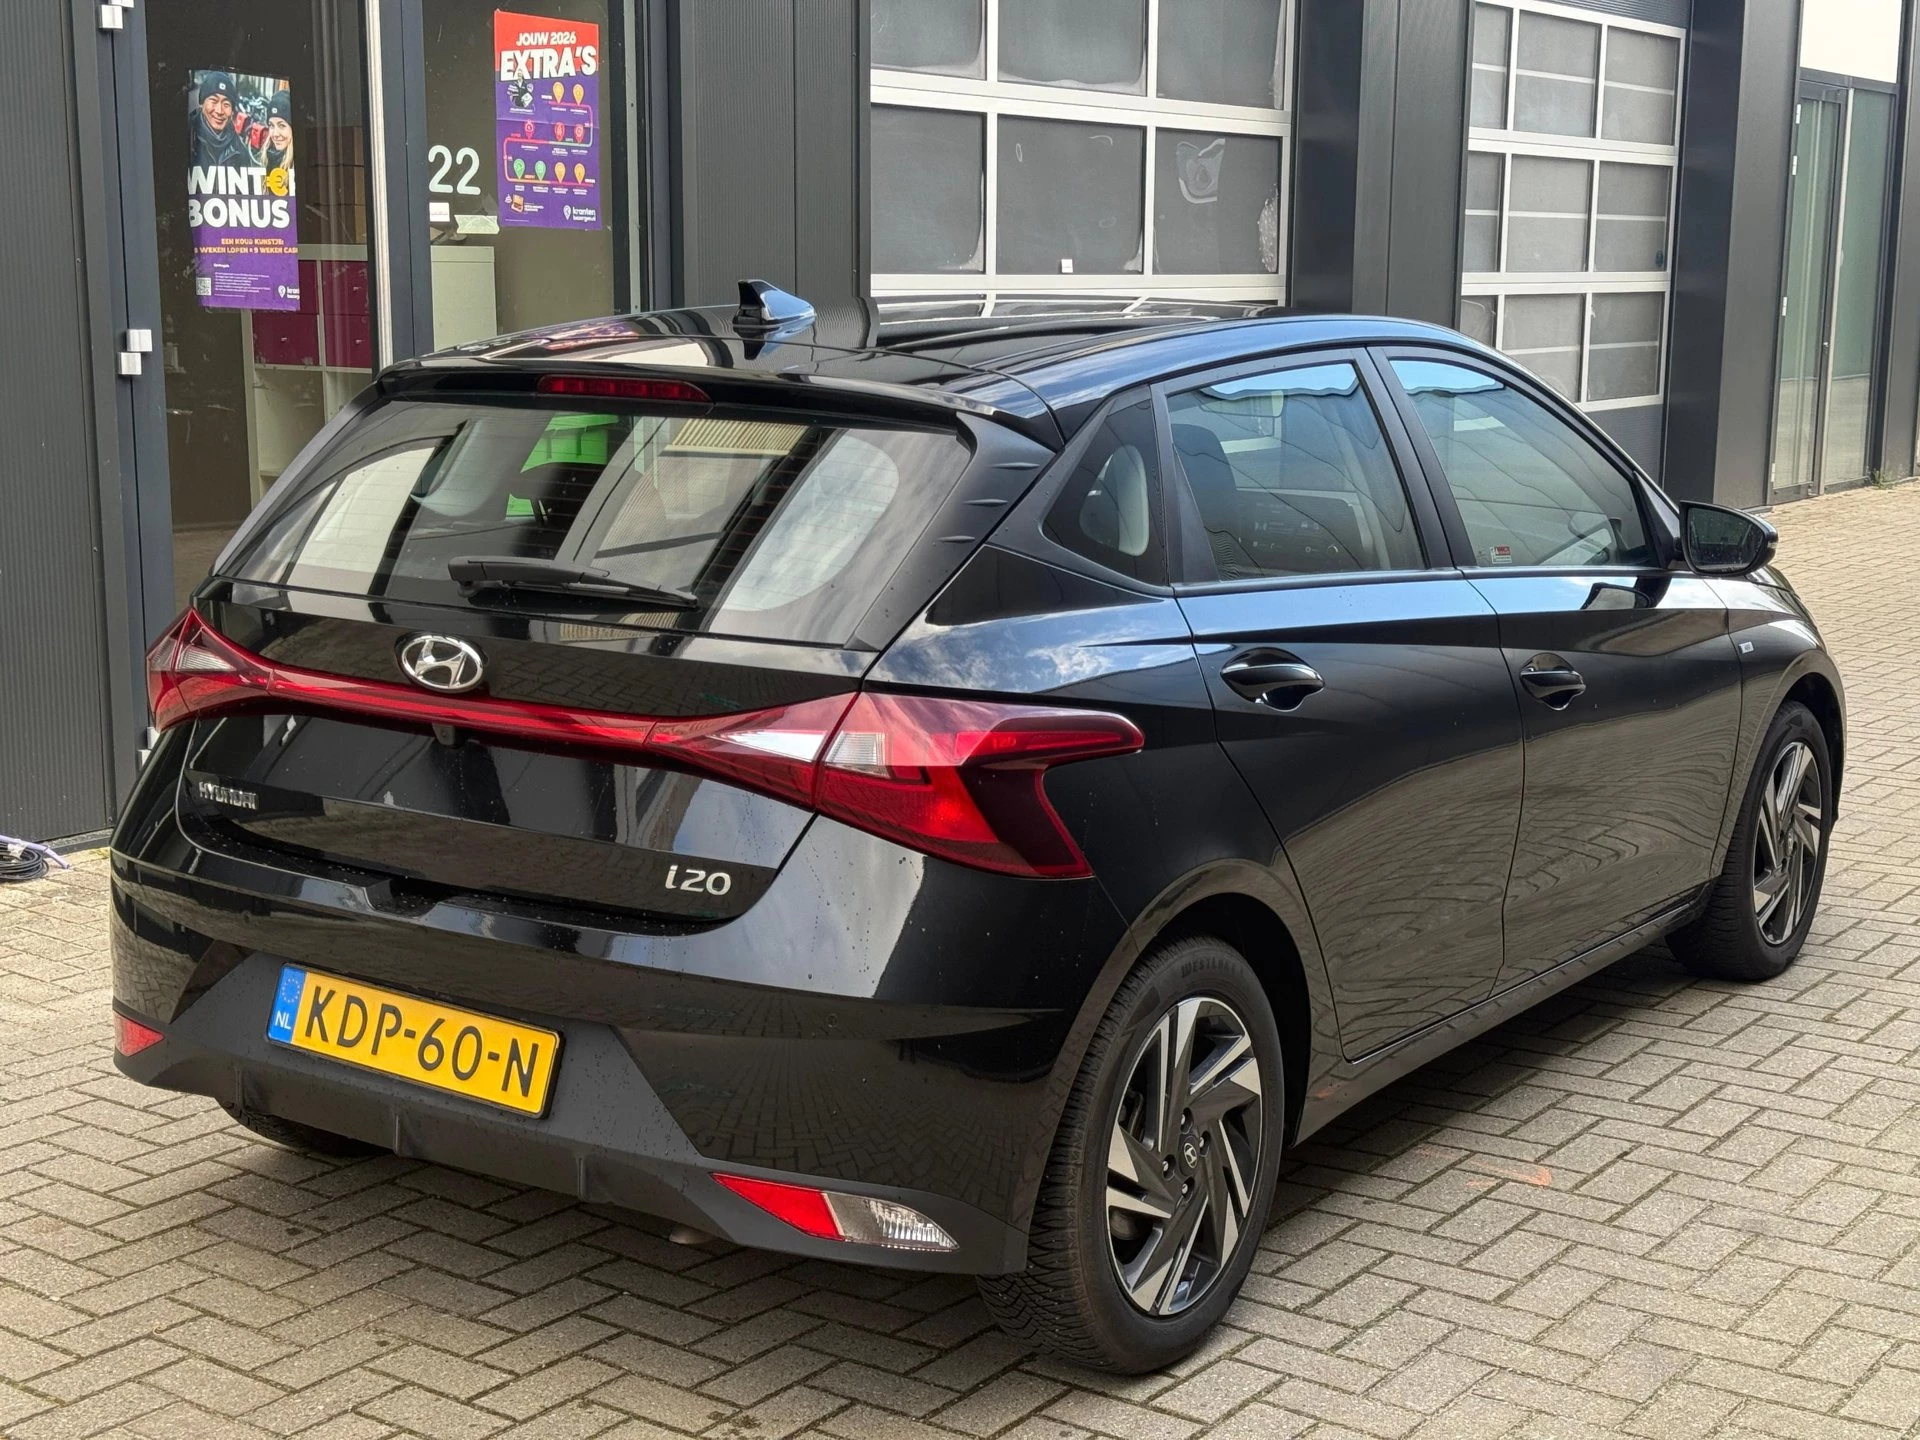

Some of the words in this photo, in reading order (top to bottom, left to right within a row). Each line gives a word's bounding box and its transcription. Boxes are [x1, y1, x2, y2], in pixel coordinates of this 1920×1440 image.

[516, 32, 549, 46] JOUW
[550, 31, 577, 45] 2026
[501, 45, 597, 81] EXTRA'S
[428, 145, 481, 195] 22
[188, 198, 290, 228] BONUS
[199, 782, 257, 809] HYUNDAI
[665, 865, 732, 895] i20
[275, 1011, 291, 1030] NL
[305, 986, 539, 1098] KDP-60-N
